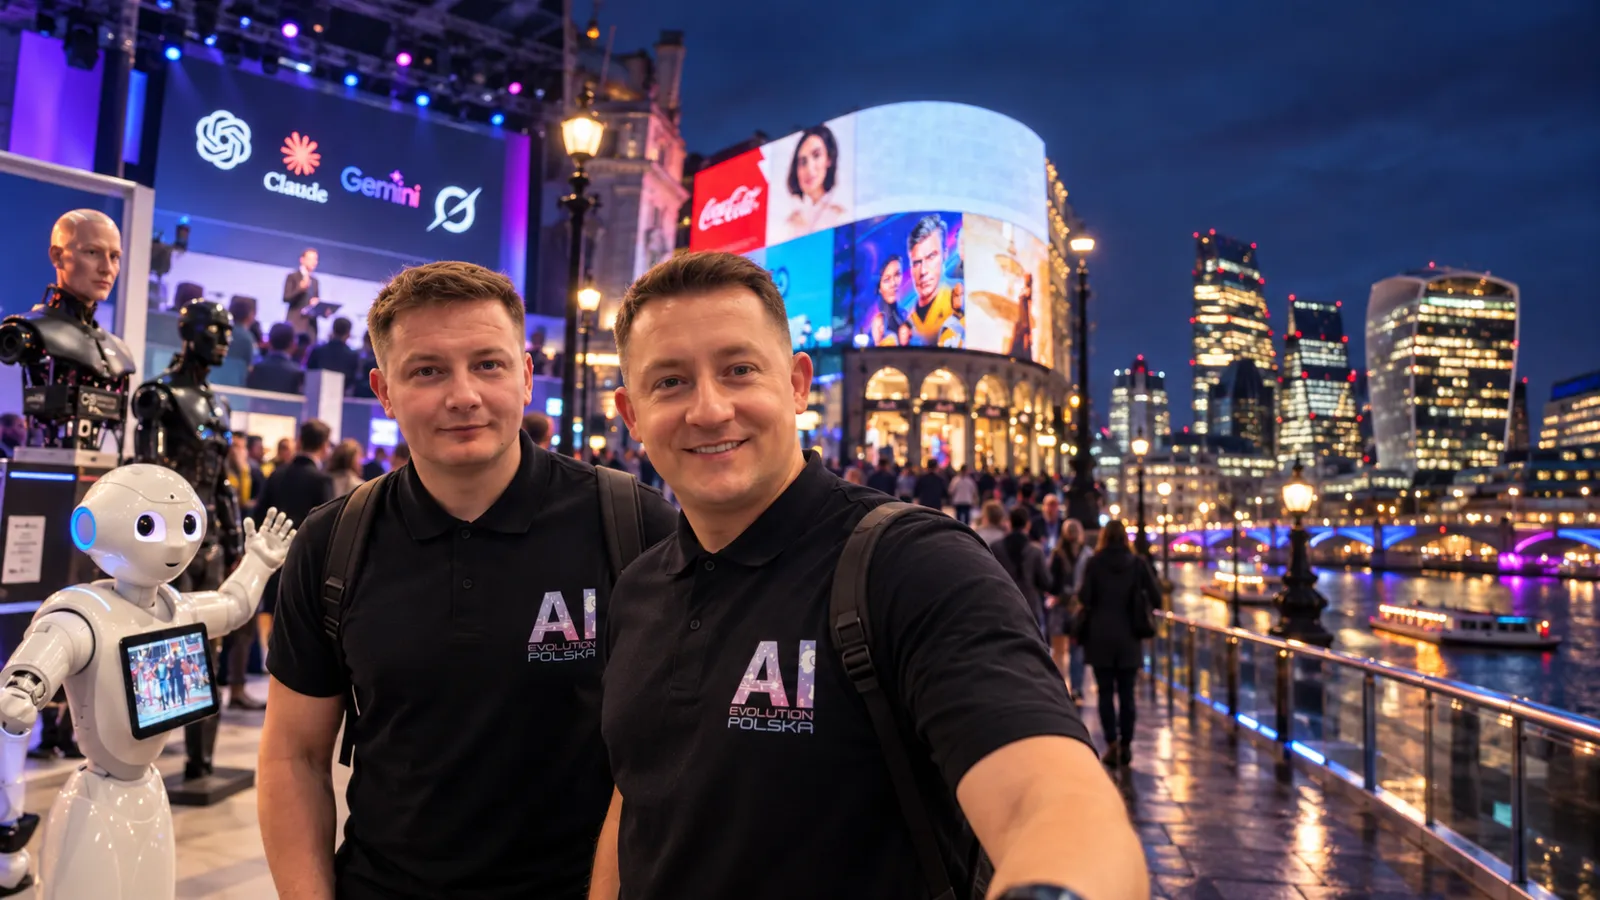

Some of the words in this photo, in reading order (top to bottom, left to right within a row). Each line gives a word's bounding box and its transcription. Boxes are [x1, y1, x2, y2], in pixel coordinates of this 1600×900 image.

[263, 171, 329, 204] Claude
[340, 165, 422, 209] Gemini
[528, 588, 596, 643] AI
[527, 640, 596, 652] EVOLUTION
[527, 648, 596, 663] POLSKA
[731, 639, 817, 708] AI
[727, 716, 814, 734] POLSKA
[729, 706, 814, 721] EVOLUTION
